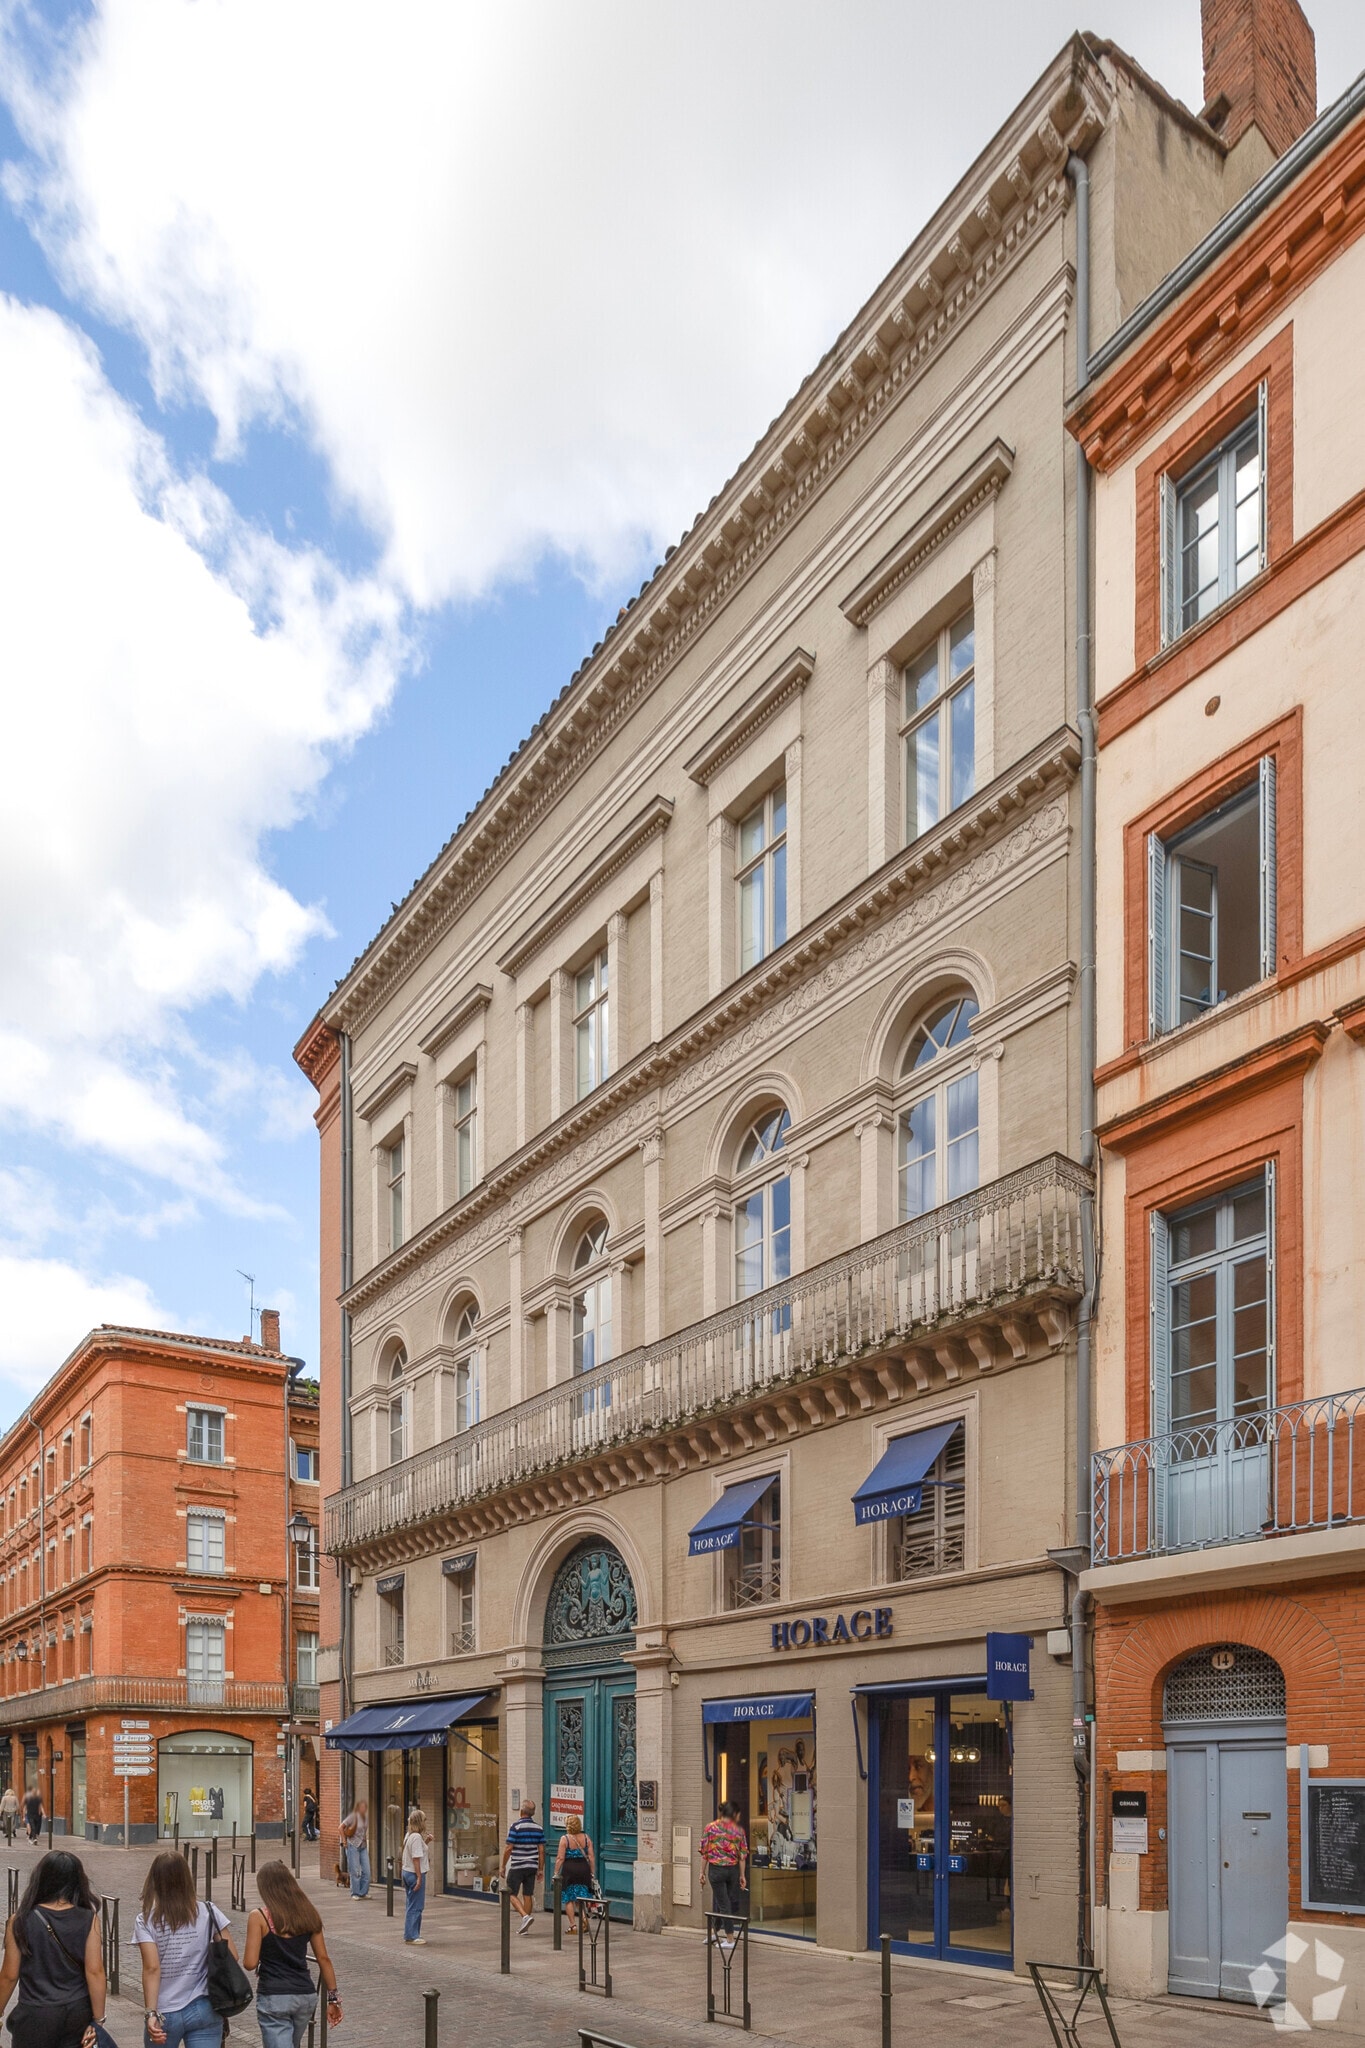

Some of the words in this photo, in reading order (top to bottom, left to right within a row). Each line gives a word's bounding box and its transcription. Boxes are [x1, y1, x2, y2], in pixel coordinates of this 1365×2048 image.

[862, 1496, 915, 1518] HORACE
[695, 1533, 733, 1550] HORACE
[770, 1607, 893, 1648] HORACE
[1217, 1653, 1230, 1666] 14
[995, 1661, 1027, 1672] HORACE
[408, 1675, 439, 1688] MADURA
[733, 1704, 774, 1717] HORACE
[919, 1857, 927, 1866] H
[950, 1859, 959, 1868] H
